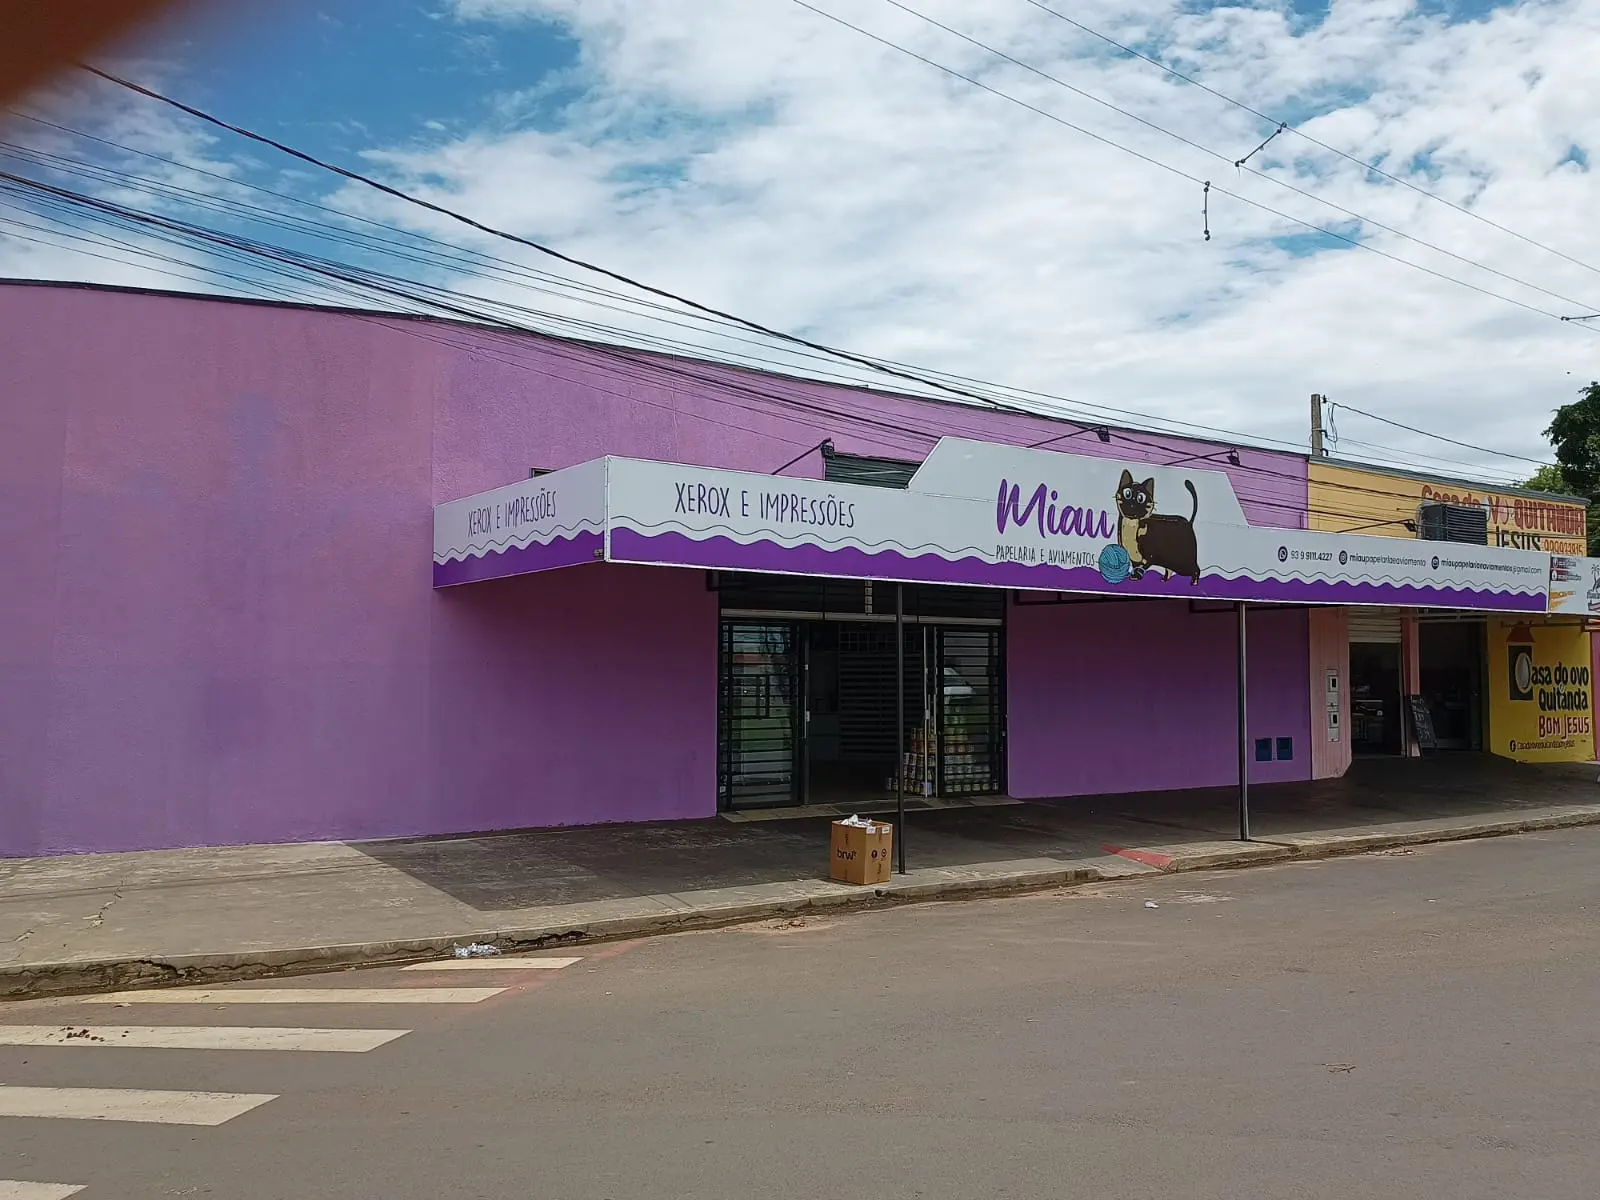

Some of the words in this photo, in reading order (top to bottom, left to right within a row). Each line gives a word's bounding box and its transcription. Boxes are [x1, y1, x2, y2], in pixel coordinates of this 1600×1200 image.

[468, 506, 492, 538] XEROX
[496, 505, 501, 530] E
[504, 487, 557, 527] IMPRESSÕES
[675, 482, 731, 519] XEROX
[741, 491, 750, 518] E
[759, 492, 856, 529] IMPRESSÕES
[996, 478, 1116, 540] Miau
[1514, 499, 1585, 536] QUITANDA
[995, 544, 1036, 563] PAPELARIA
[1041, 550, 1045, 562] E
[1048, 552, 1096, 567] AVIAMENTOS
[1554, 661, 1569, 685] do
[1570, 666, 1590, 686] ovo
[1539, 688, 1588, 711] Quitanda
[1539, 715, 1560, 738] BOM
[1561, 713, 1590, 740] JESUS
